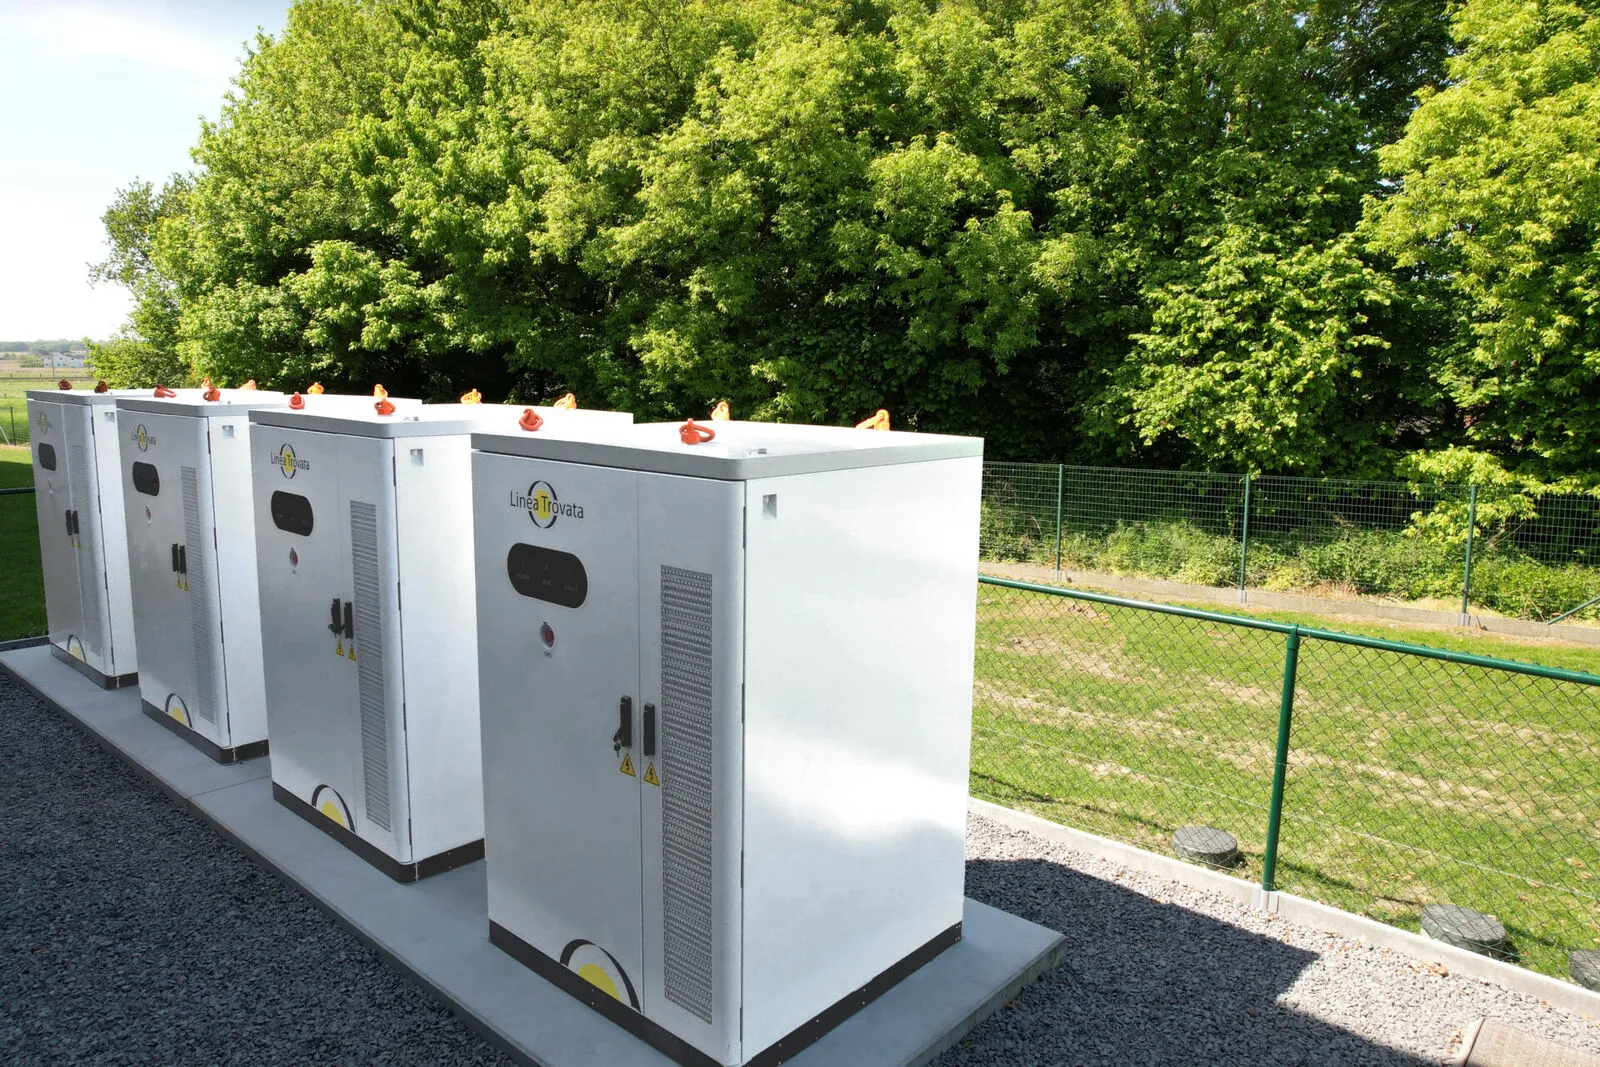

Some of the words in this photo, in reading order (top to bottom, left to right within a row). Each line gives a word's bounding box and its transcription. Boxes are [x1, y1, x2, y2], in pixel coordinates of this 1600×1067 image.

[270, 452, 287, 466] Linea
[287, 454, 310, 471] Trovata
[510, 491, 539, 511] Linea
[540, 495, 584, 519] Trovata
